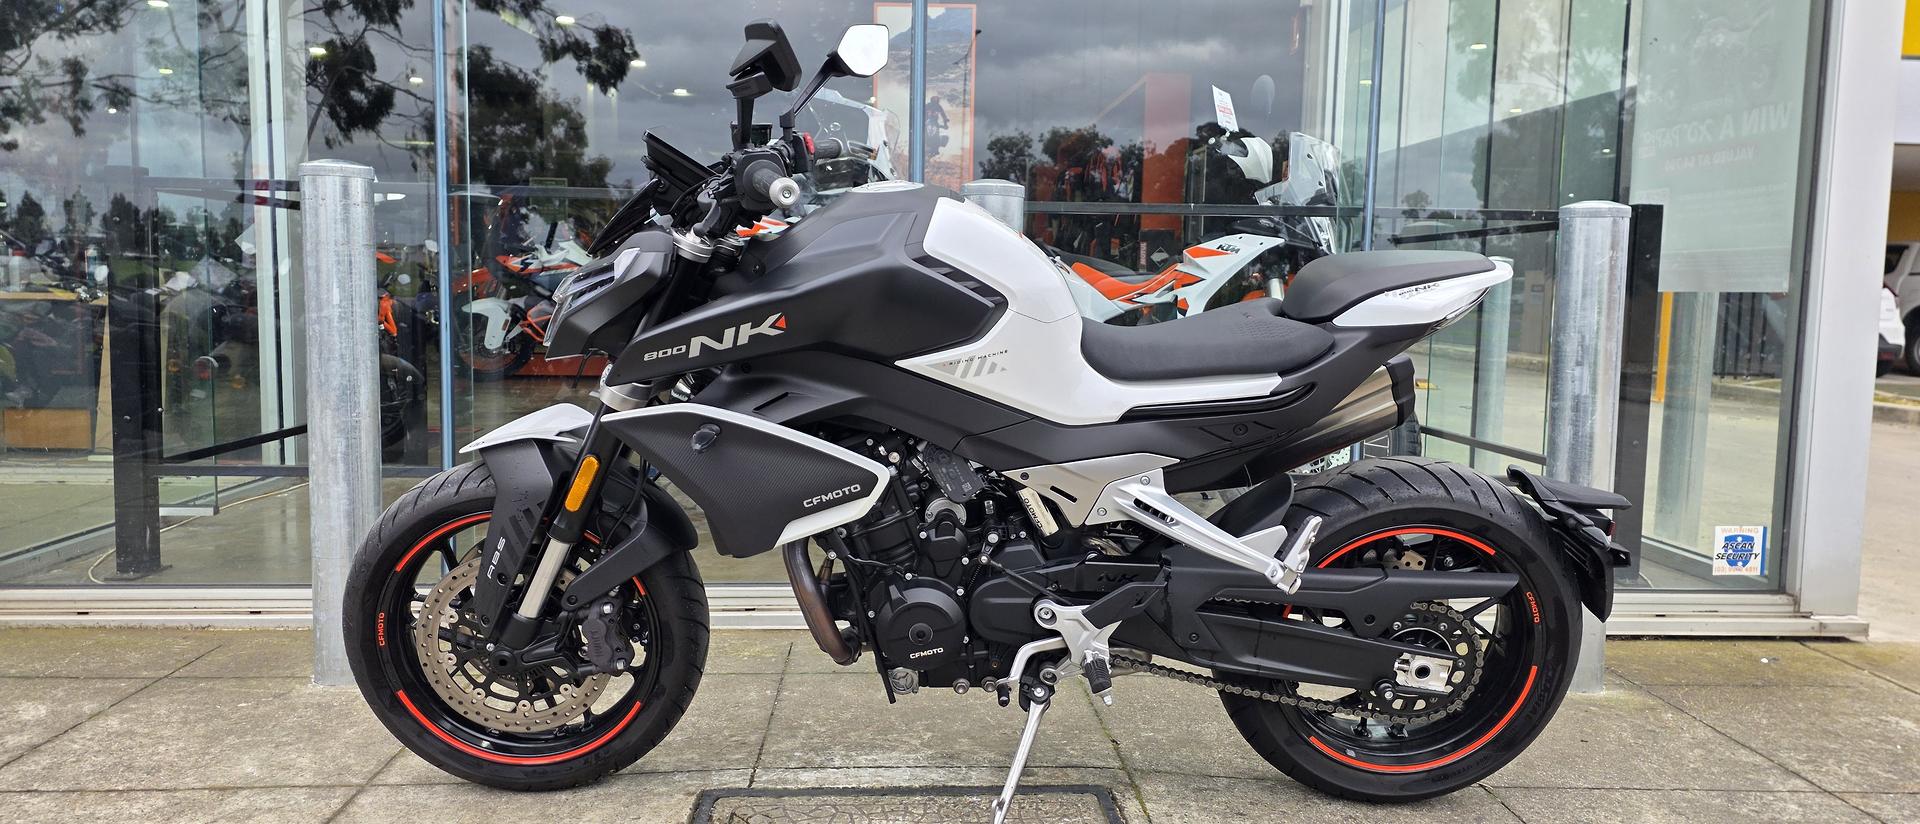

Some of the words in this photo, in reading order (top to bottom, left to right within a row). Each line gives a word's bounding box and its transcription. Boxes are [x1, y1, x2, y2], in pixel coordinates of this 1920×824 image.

[1216, 243, 1241, 254] KTM
[643, 344, 687, 361] 800
[688, 312, 786, 359] NK
[949, 356, 975, 366] RIDING
[977, 349, 1009, 360] MACHINE
[803, 483, 861, 508] CFMOTO
[1023, 497, 1044, 530] CFMOTO
[486, 536, 506, 580] ABS
[1714, 552, 1761, 560] SECURITY
[1526, 591, 1540, 623] CFMOTO
[377, 612, 386, 646] CFMOTO
[909, 647, 944, 659] CFMOTO
